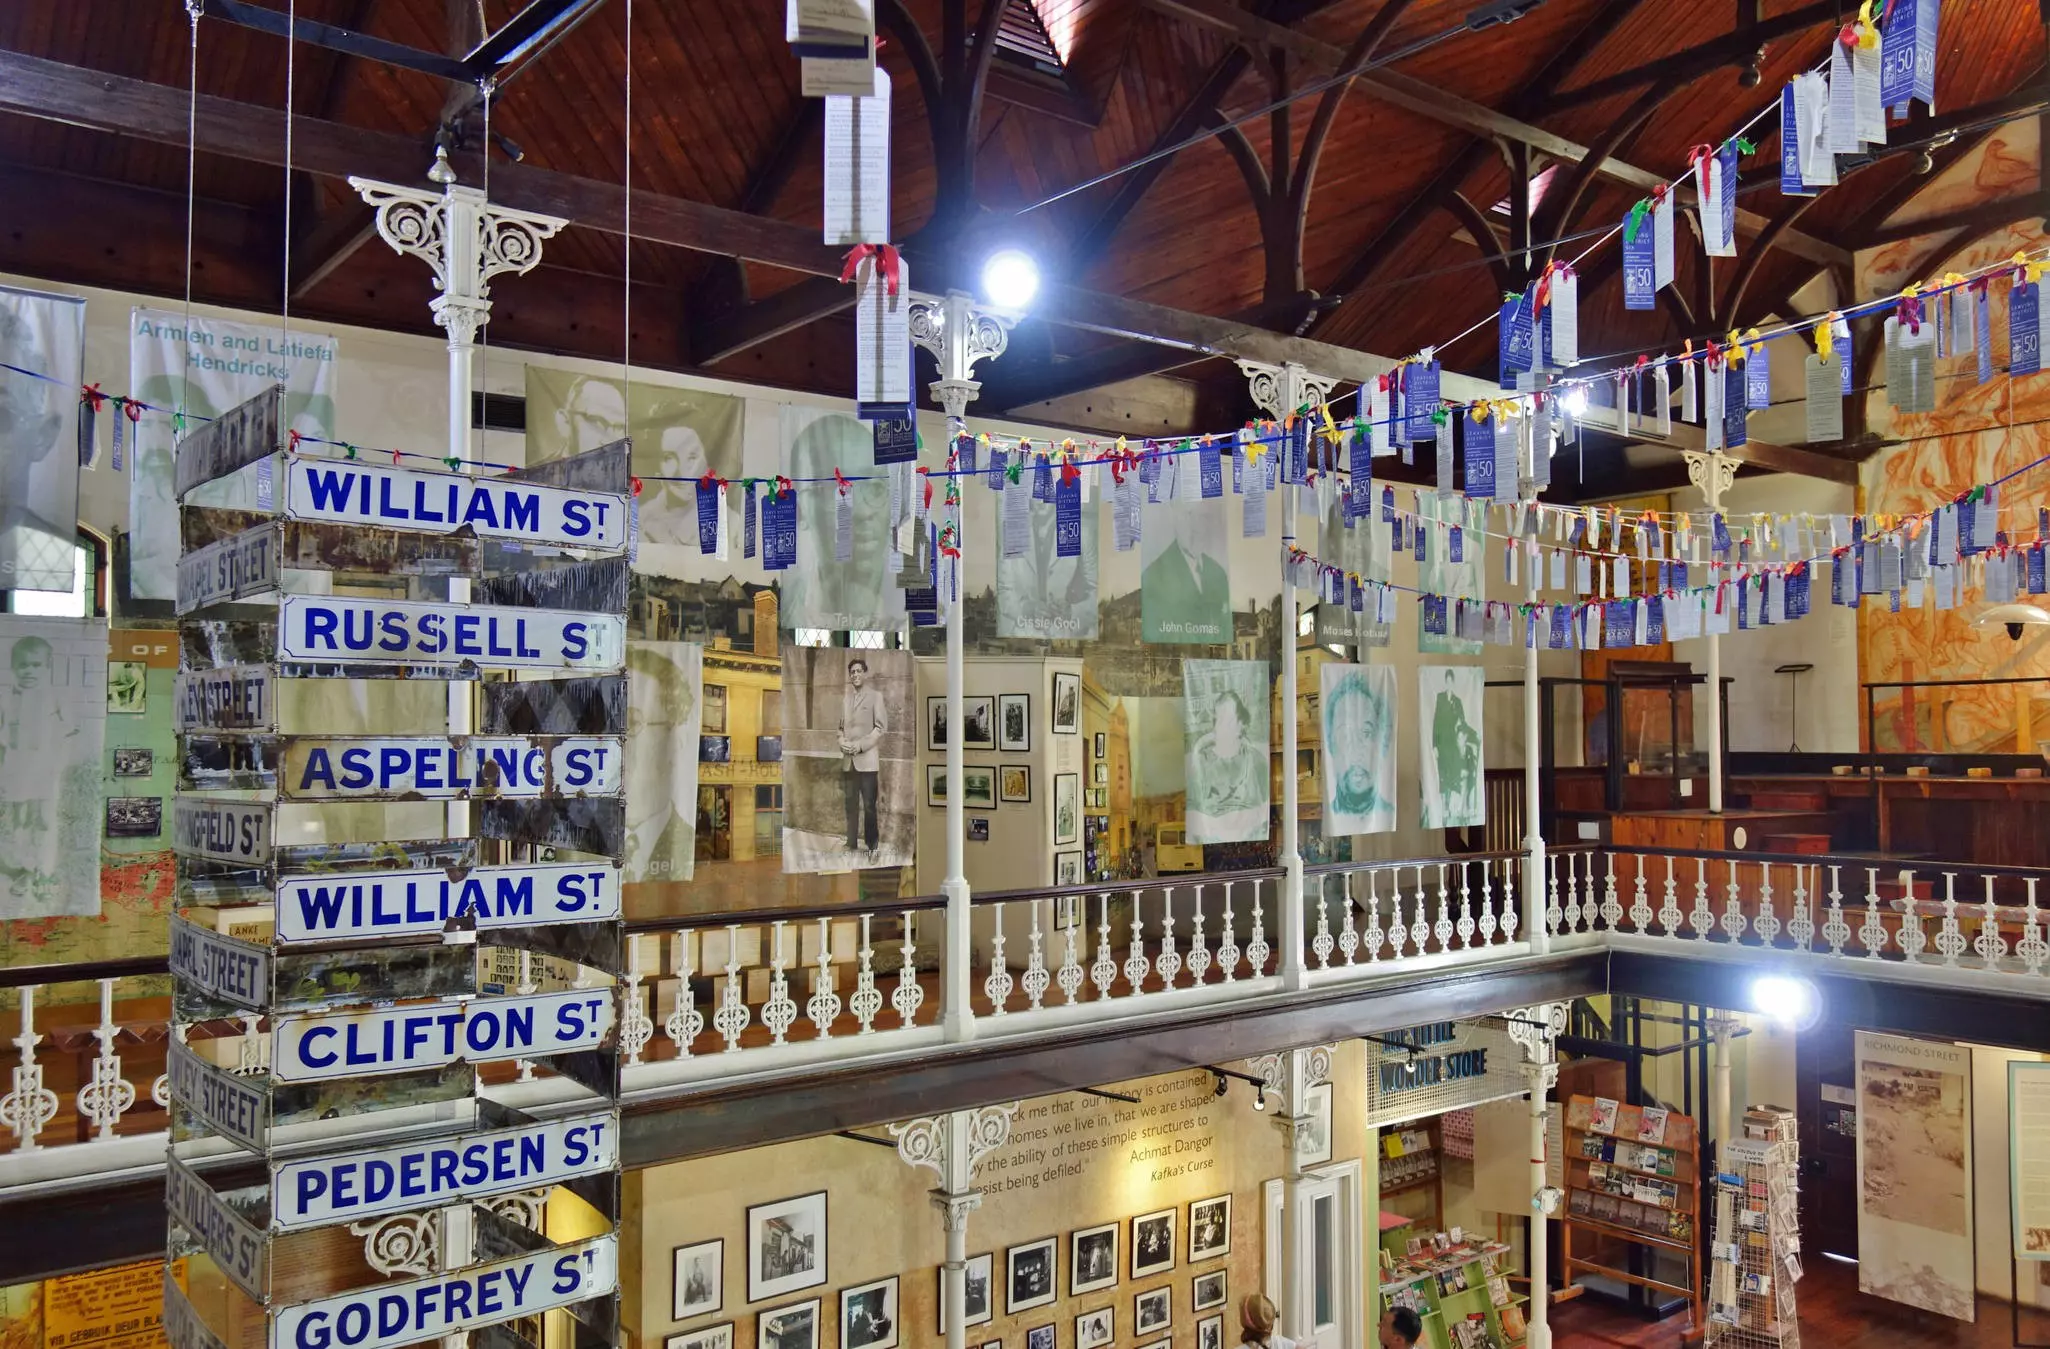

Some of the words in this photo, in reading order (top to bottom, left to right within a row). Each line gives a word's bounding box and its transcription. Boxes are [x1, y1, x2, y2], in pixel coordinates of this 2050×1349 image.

[1897, 47, 1914, 73] 50
[1637, 268, 1651, 287] 50
[138, 321, 214, 346] Armien
[222, 335, 259, 351] and
[267, 339, 332, 361] Latiefa
[2024, 334, 2037, 353] 50
[187, 351, 289, 379] Hendricks
[1758, 382, 1768, 395] 50
[1210, 472, 1220, 483] 50
[1265, 462, 1274, 475] 50
[1479, 460, 1493, 477] 50
[306, 468, 540, 532] WILLIAM
[1361, 480, 1370, 497] 50
[708, 521, 718, 536] 50
[785, 532, 795, 547] 50
[1068, 522, 1079, 538] 50
[218, 538, 267, 592] STREET
[305, 607, 540, 658] RUSSELL
[1017, 616, 1050, 628] Cissie
[1053, 616, 1080, 630] Gool
[1159, 622, 1183, 633] John
[1186, 622, 1220, 634] Gomas
[1323, 625, 1352, 637] Moses
[132, 644, 168, 655] OF
[300, 747, 545, 789] ASPELING
[297, 877, 533, 930] WILLIAM
[201, 943, 259, 999] STREET
[298, 1006, 533, 1068] CLIFTON
[1864, 1038, 1922, 1056] RICHMOND
[1924, 1049, 1961, 1062] STREET
[1446, 1048, 1488, 1079] STORE
[203, 1072, 259, 1139] STREET
[1029, 1107, 1047, 1119] me
[1052, 1100, 1074, 1115] that
[1082, 1095, 1100, 1109] our
[1145, 1084, 1153, 1096] is
[1156, 1073, 1207, 1095] contained
[1007, 1129, 1047, 1145] homes
[1053, 1122, 1071, 1135] we
[1075, 1117, 1094, 1132] live
[1098, 1114, 1111, 1128] in,
[1114, 1110, 1136, 1125] that
[1141, 1105, 1157, 1117] we
[1160, 1101, 1177, 1113] are
[1180, 1092, 1216, 1111] shaped
[988, 1156, 1007, 1172] the
[1011, 1147, 1046, 1167] ability
[1052, 1142, 1065, 1156] of
[1067, 1138, 1098, 1155] these
[1101, 1130, 1136, 1150] simple
[1142, 1120, 1195, 1138] structures
[1197, 1115, 1208, 1126] to
[1130, 1145, 1172, 1164] Achmat
[1175, 1135, 1213, 1156] Dangor
[297, 1134, 544, 1215] PEDERSEN
[1151, 1166, 1185, 1182] Kafka's
[1188, 1158, 1213, 1172] Curse
[976, 1182, 1003, 1196] esist
[1006, 1174, 1039, 1190] being
[295, 1263, 534, 1349] GODFREY
